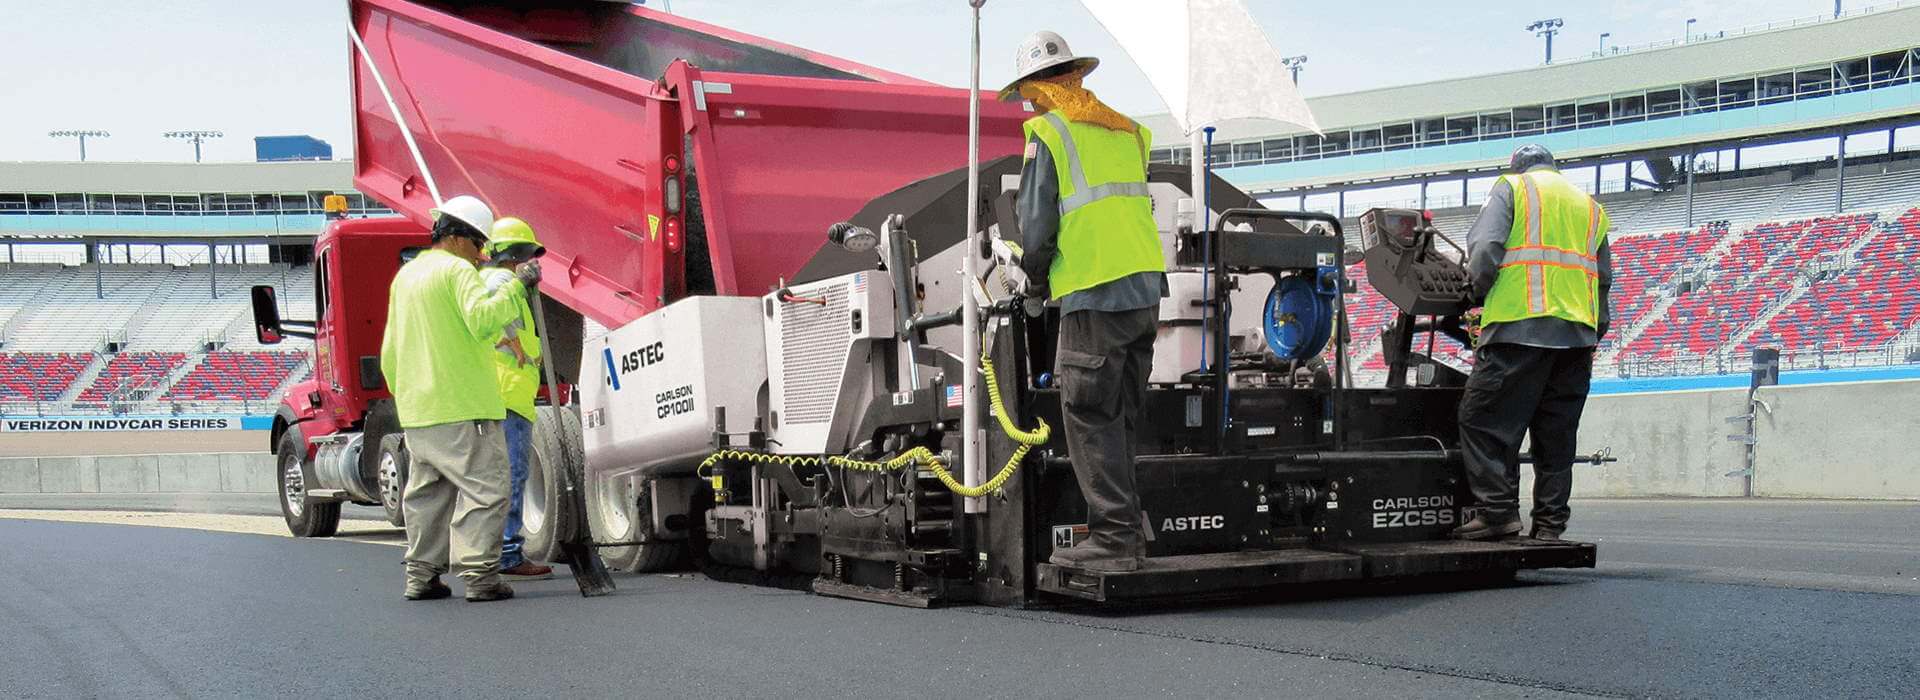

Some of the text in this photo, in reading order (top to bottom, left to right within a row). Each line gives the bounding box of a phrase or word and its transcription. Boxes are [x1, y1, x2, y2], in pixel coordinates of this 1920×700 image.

[621, 341, 664, 374] ASTEC
[655, 384, 693, 404] CARLSON
[657, 399, 695, 419] CP100II
[7, 418, 228, 430] VERIZON INDYCAR SERIES
[1372, 495, 1454, 510] CARLSON
[1161, 515, 1225, 532] ASTEC
[1372, 509, 1455, 528] EZCSS
